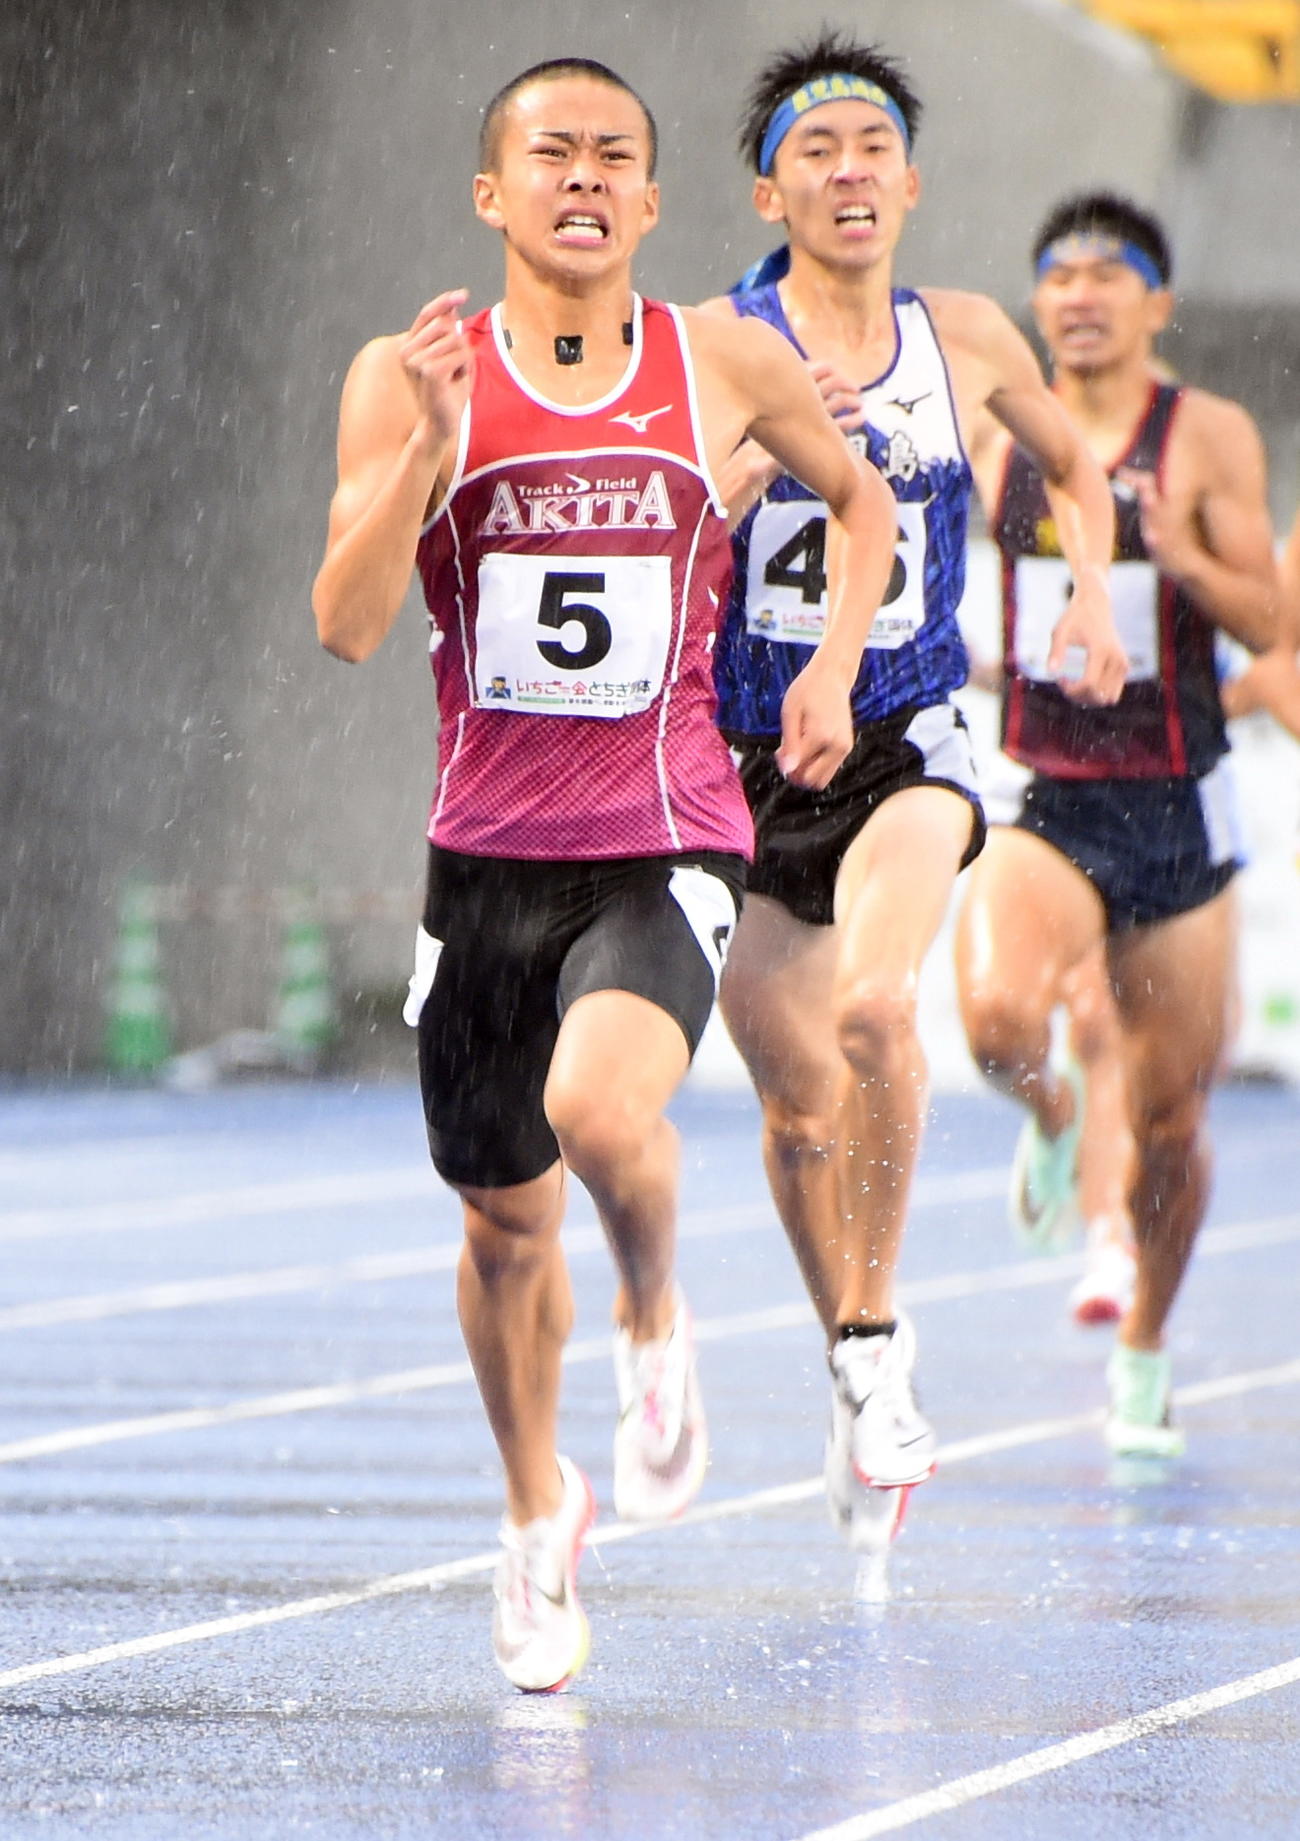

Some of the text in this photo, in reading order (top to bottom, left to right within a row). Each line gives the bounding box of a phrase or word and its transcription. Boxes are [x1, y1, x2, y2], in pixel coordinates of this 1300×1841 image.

[478, 470, 677, 535] AKITA
[518, 477, 637, 497] Track Field
[536, 571, 612, 671] 5
